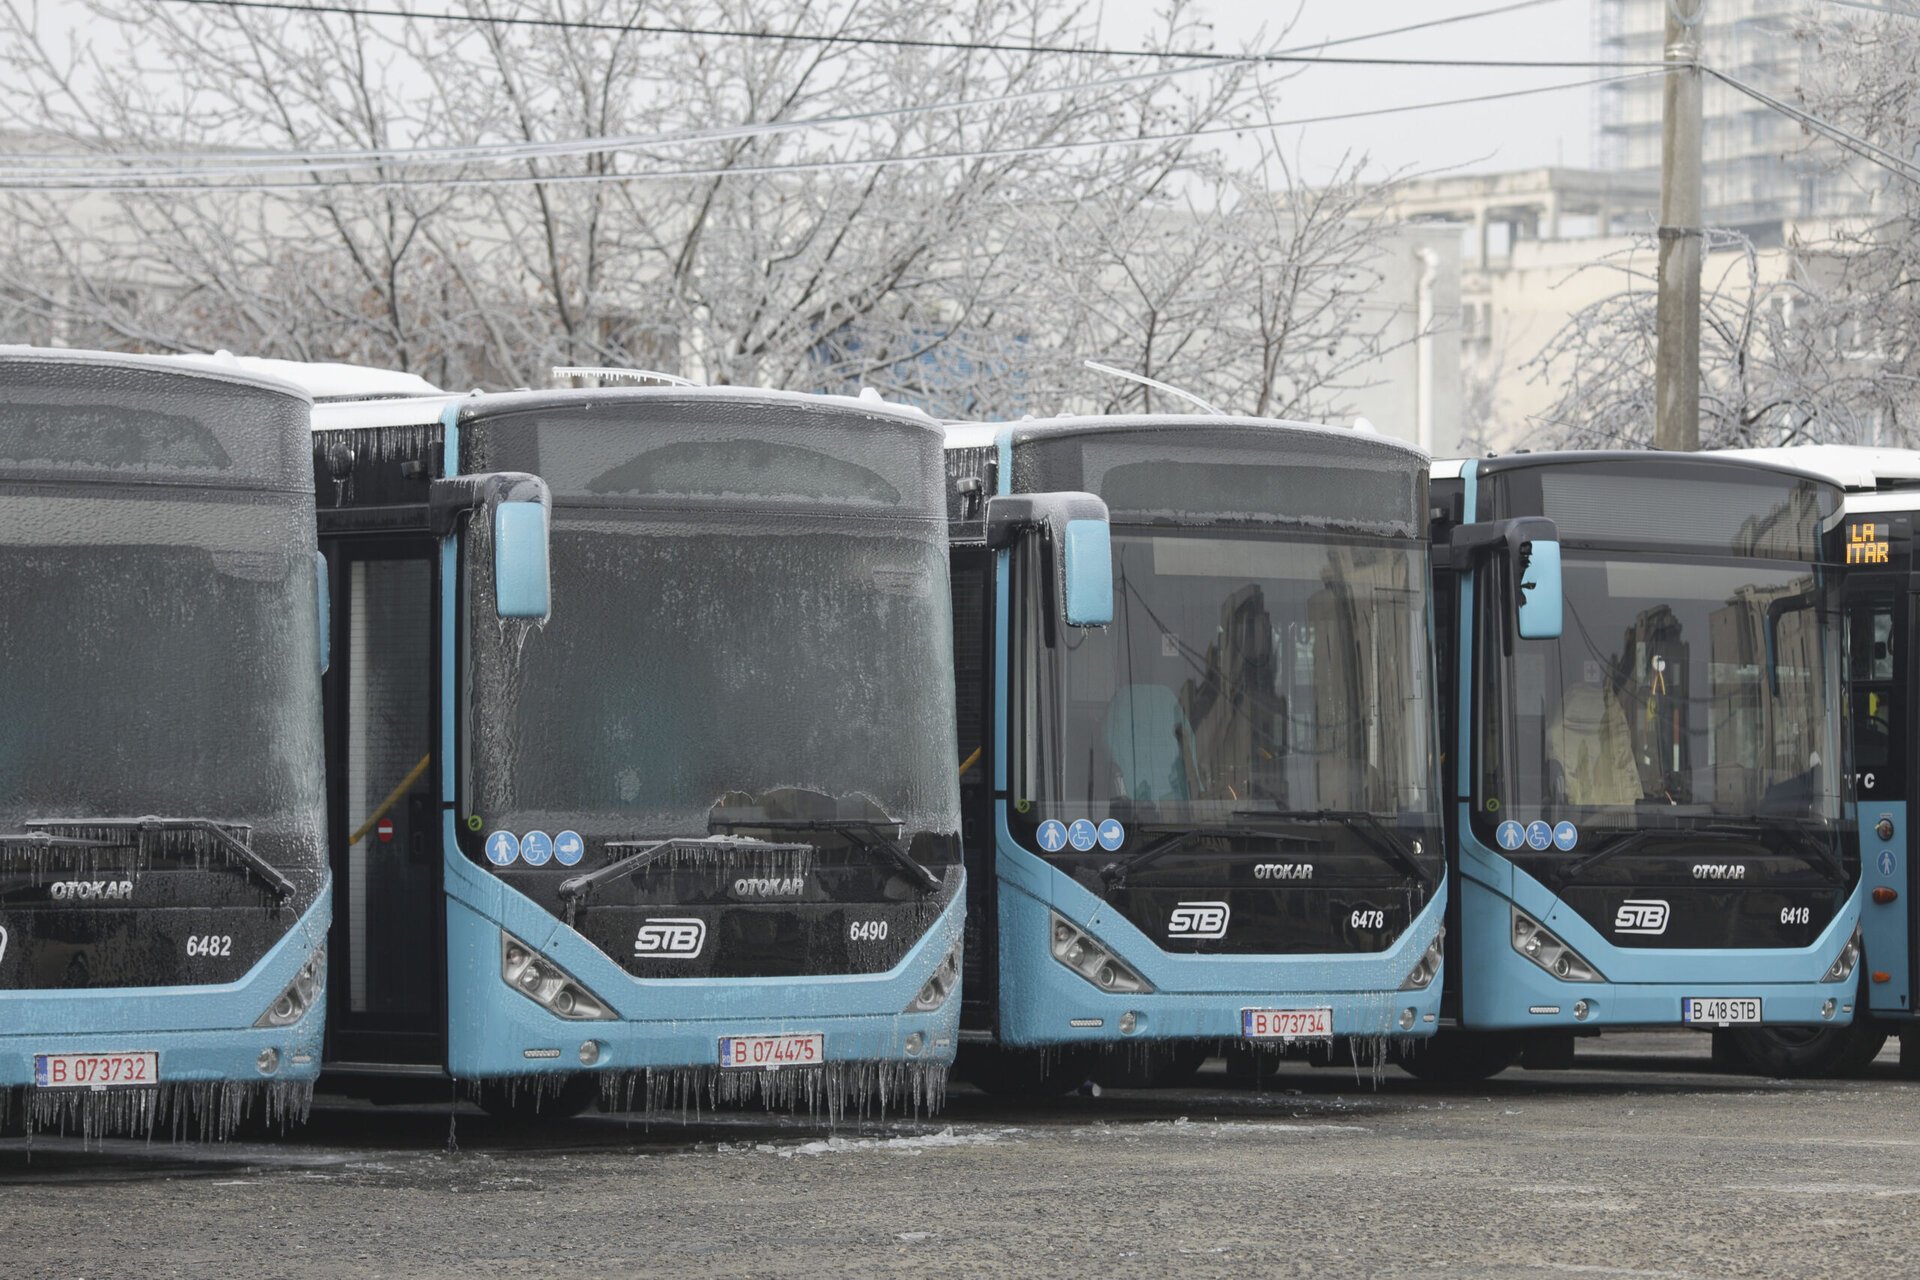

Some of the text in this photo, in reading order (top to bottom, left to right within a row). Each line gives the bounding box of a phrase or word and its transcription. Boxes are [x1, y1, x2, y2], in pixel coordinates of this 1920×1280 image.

[1852, 523, 1875, 542] LA
[1253, 864, 1313, 880] OTOKAR
[1692, 864, 1745, 880] OTOKAR
[50, 881, 134, 900] OTOKAR
[734, 878, 804, 896] OTOKAR
[1168, 908, 1224, 932] STB
[1351, 910, 1384, 929] 6478
[1614, 905, 1665, 928] STB
[1780, 907, 1810, 925] 6418
[634, 925, 700, 951] STB
[850, 921, 888, 941] 6490
[186, 935, 232, 956] 6482
[1693, 1002, 1756, 1020] B 418 STB
[1256, 1014, 1267, 1034] B
[1272, 1014, 1325, 1033] 073734
[735, 1039, 814, 1063] B 074475
[53, 1057, 146, 1082] B 073732
